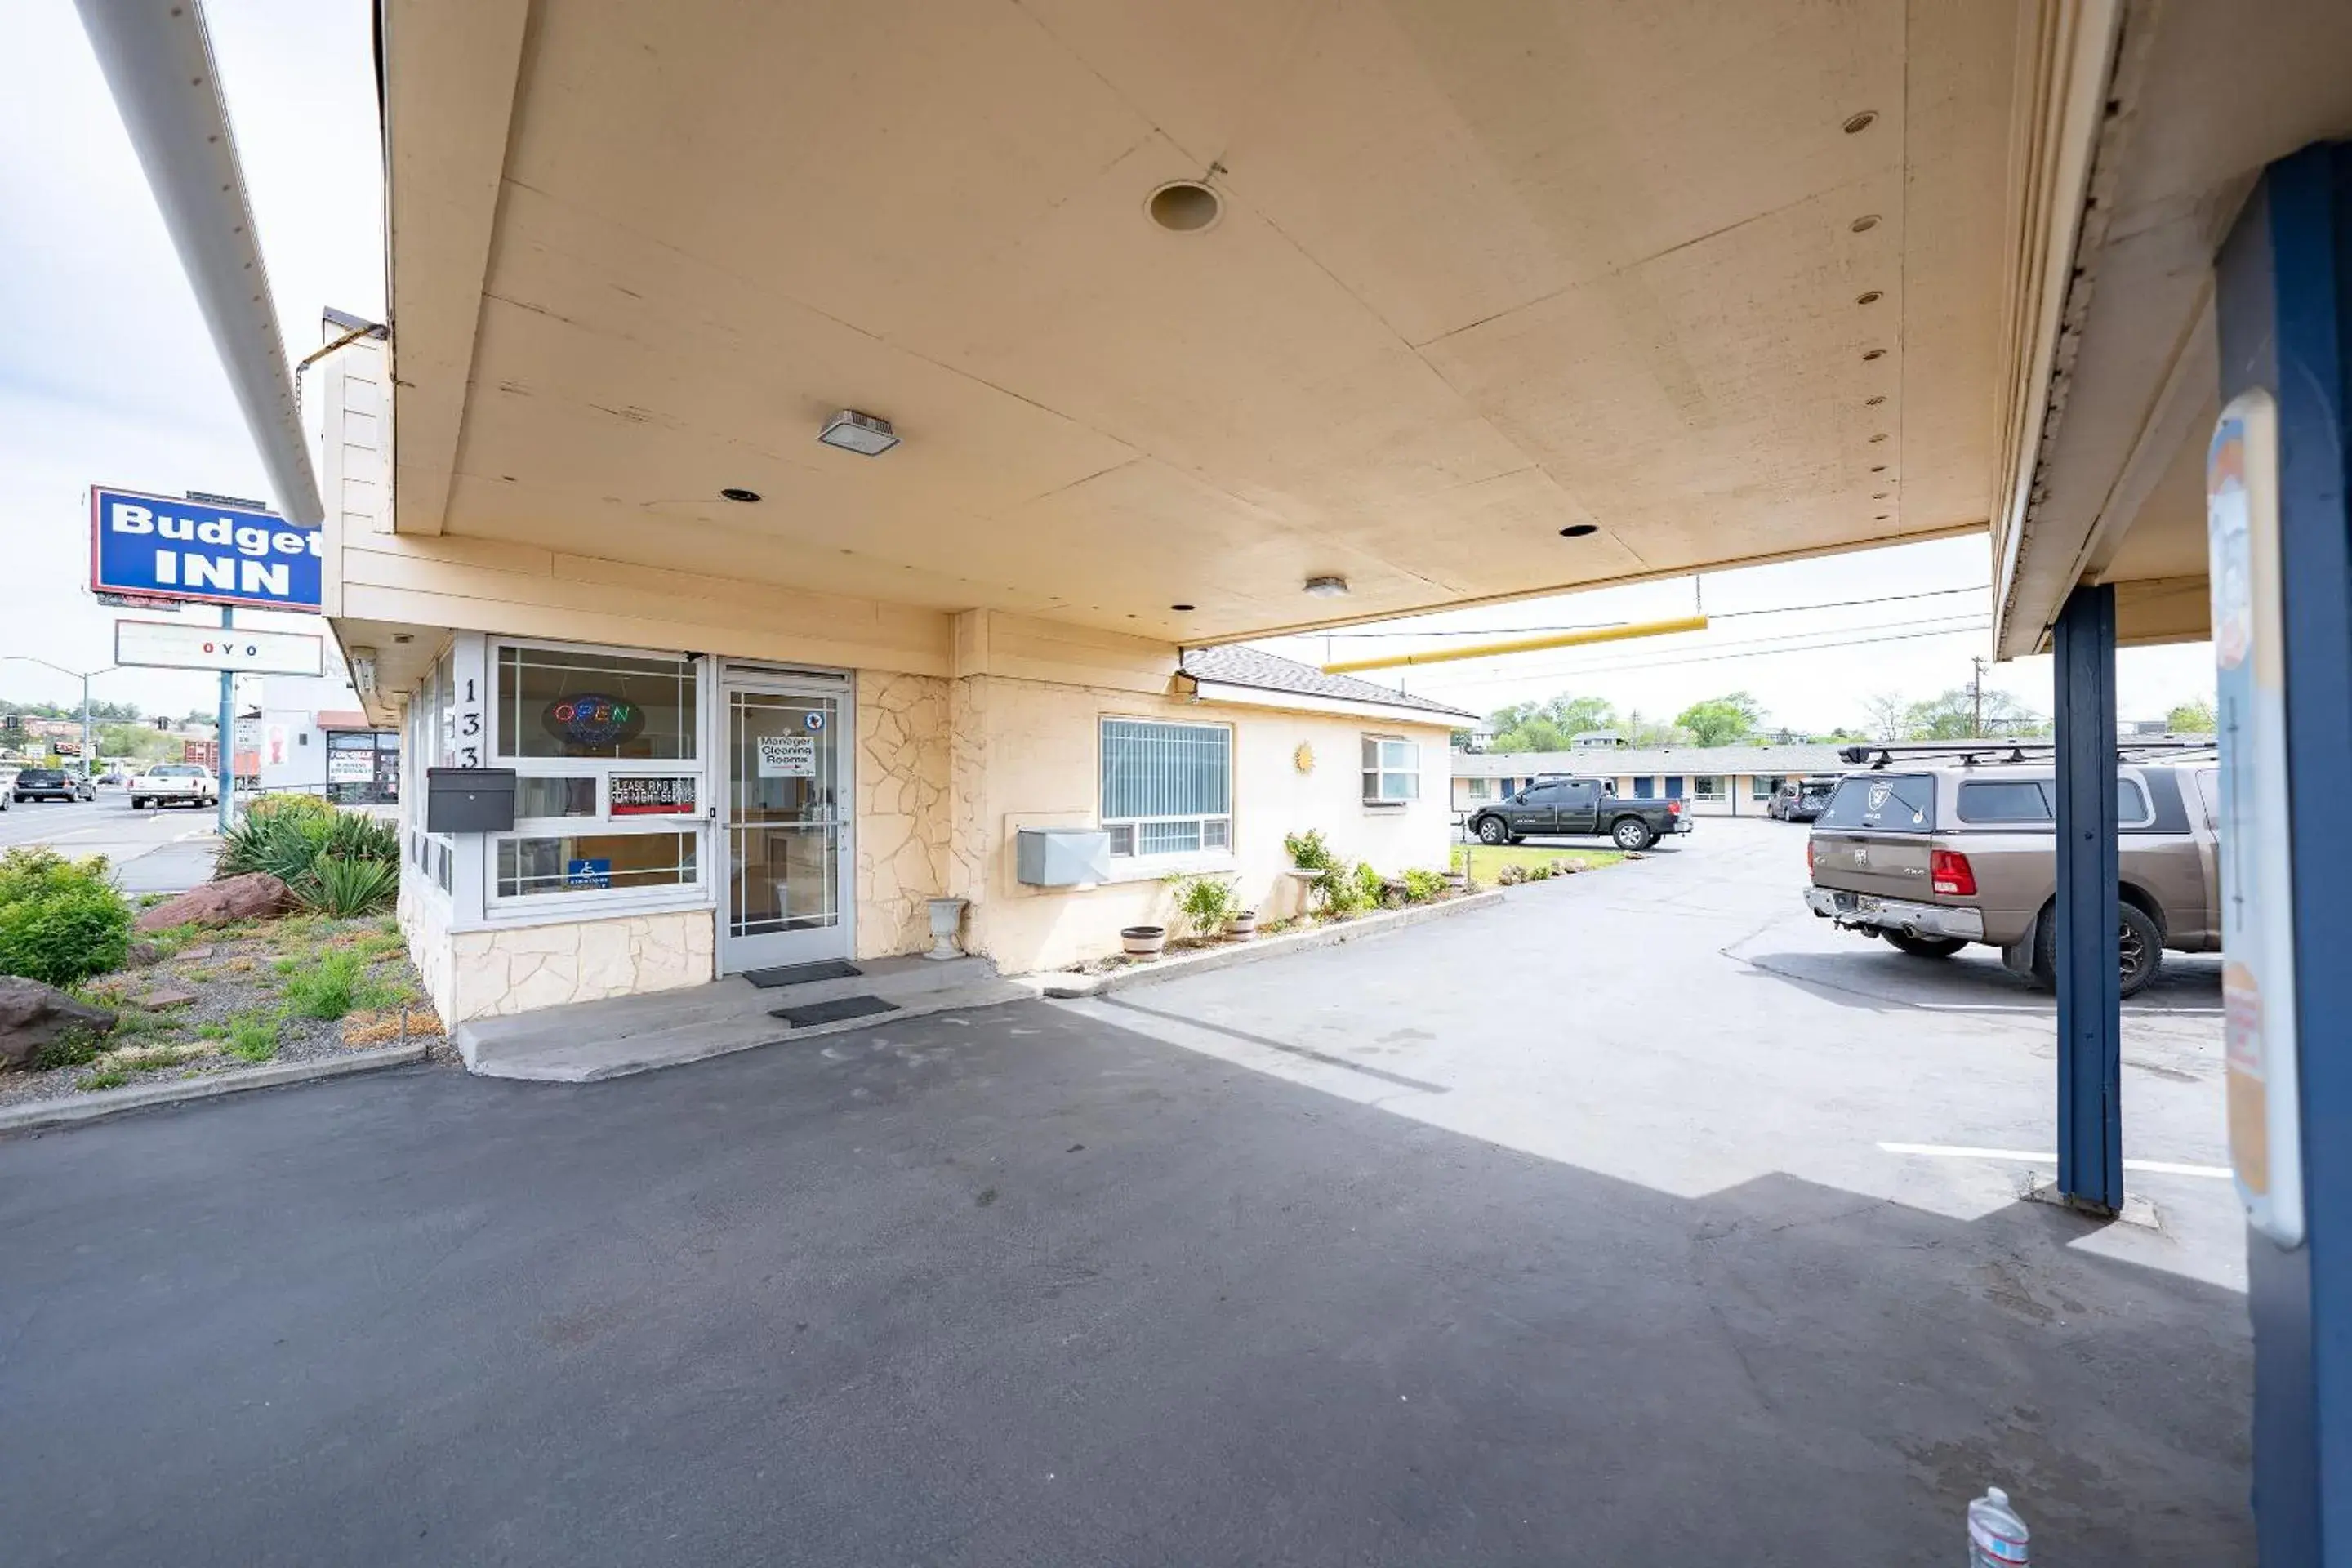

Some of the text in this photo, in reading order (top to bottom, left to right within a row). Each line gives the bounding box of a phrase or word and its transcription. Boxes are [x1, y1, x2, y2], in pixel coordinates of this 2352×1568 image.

[112, 503, 322, 557] Budget
[155, 550, 289, 595] INN
[554, 704, 630, 722] OPEN
[761, 737, 811, 747] Manager
[761, 746, 812, 755] Cleaning
[766, 755, 808, 764] Rooms
[611, 779, 645, 791] PLEASE
[611, 791, 630, 803] FOR
